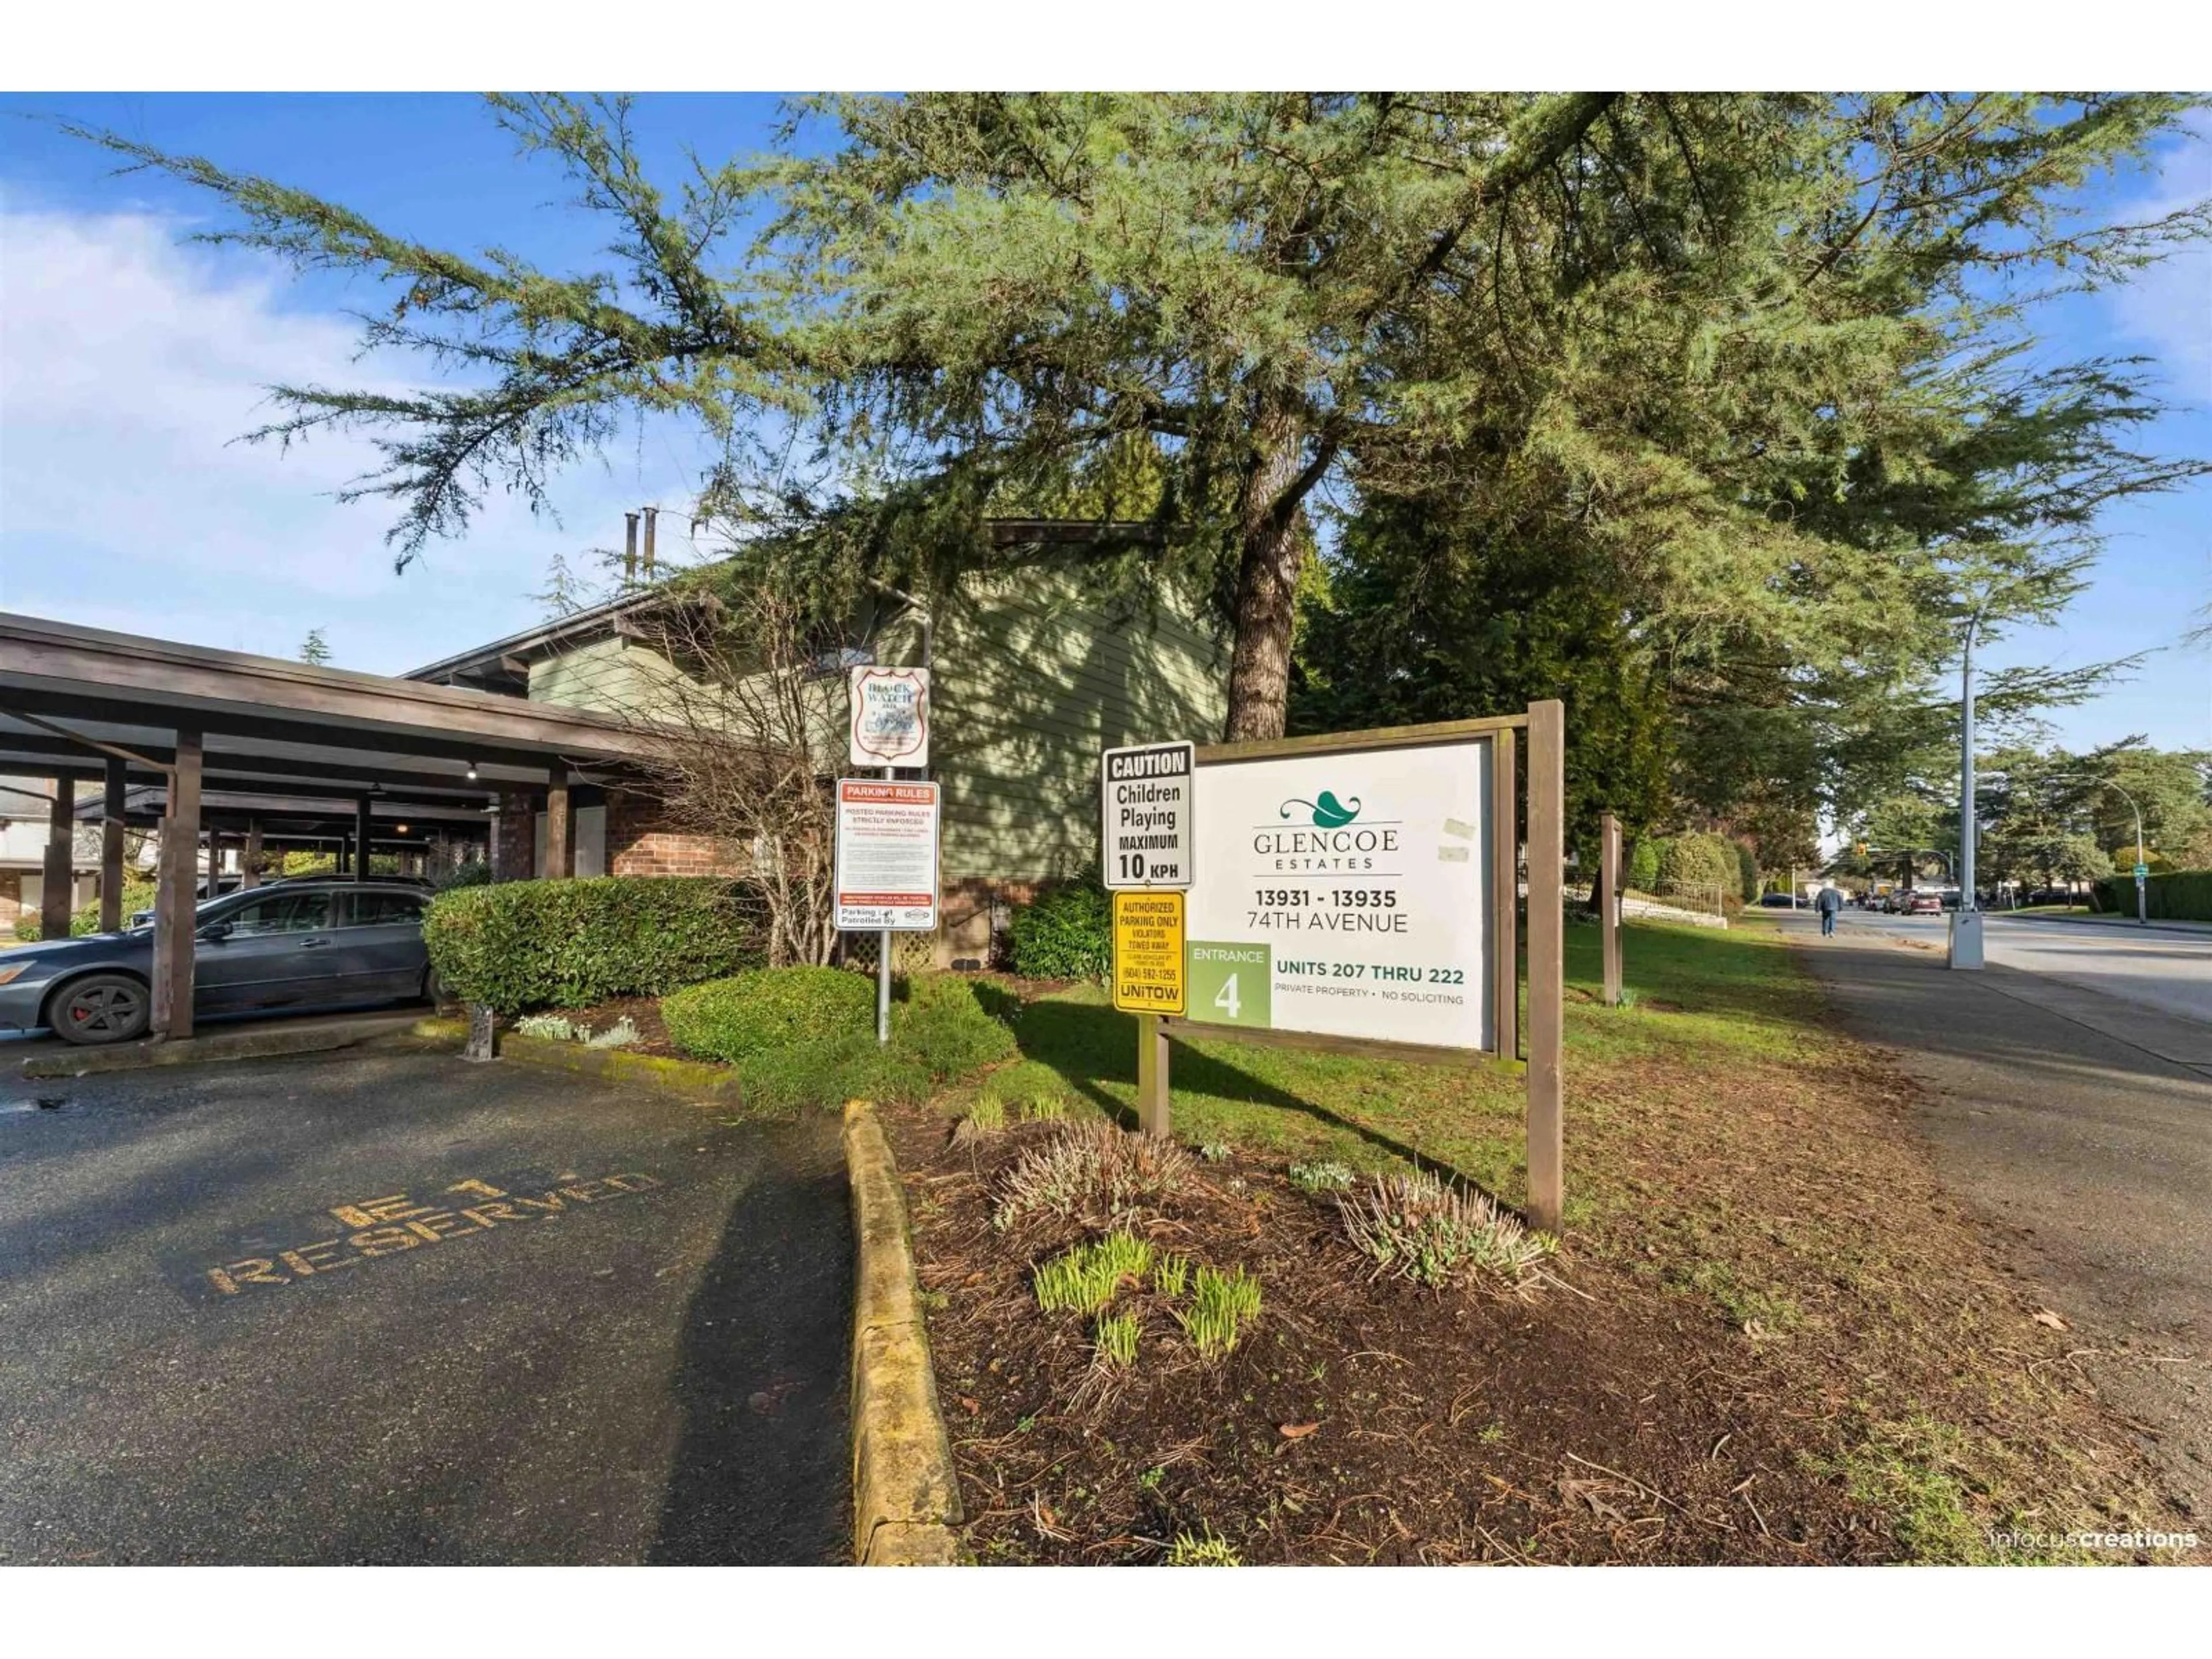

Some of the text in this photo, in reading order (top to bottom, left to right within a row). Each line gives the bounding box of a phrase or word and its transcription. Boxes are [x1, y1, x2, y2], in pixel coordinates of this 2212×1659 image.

[868, 693, 912, 703] WATCH
[1112, 751, 1185, 778] CAUTION
[847, 786, 930, 798] PARKING RULES
[1117, 783, 1180, 805] Children
[1121, 806, 1176, 831] Playing
[1119, 834, 1179, 851] MAXIMUM
[1253, 830, 1399, 854] GLENCOE
[1119, 854, 1179, 878] 10 KPH
[1275, 858, 1373, 870] ESTATES
[1255, 890, 1309, 906] 13931
[1332, 891, 1396, 907] 13935
[842, 908, 876, 917] Parking
[1124, 902, 1175, 914] AUTHORIZED
[1120, 916, 1179, 927] PARKING ONLY
[1248, 911, 1408, 933] 74TH AVENUE
[1132, 929, 1166, 939] VIOLATORS
[1128, 940, 1170, 951] TOWED AWAY
[1194, 948, 1265, 964] ENTRANCE
[1277, 960, 1464, 985] UNITS 207 THRU 222
[1214, 973, 1242, 1018] 4
[1274, 983, 1464, 1005] PRIVATE PROPERTY NO SOLICITING
[207, 1173, 661, 1294] RESERVED
